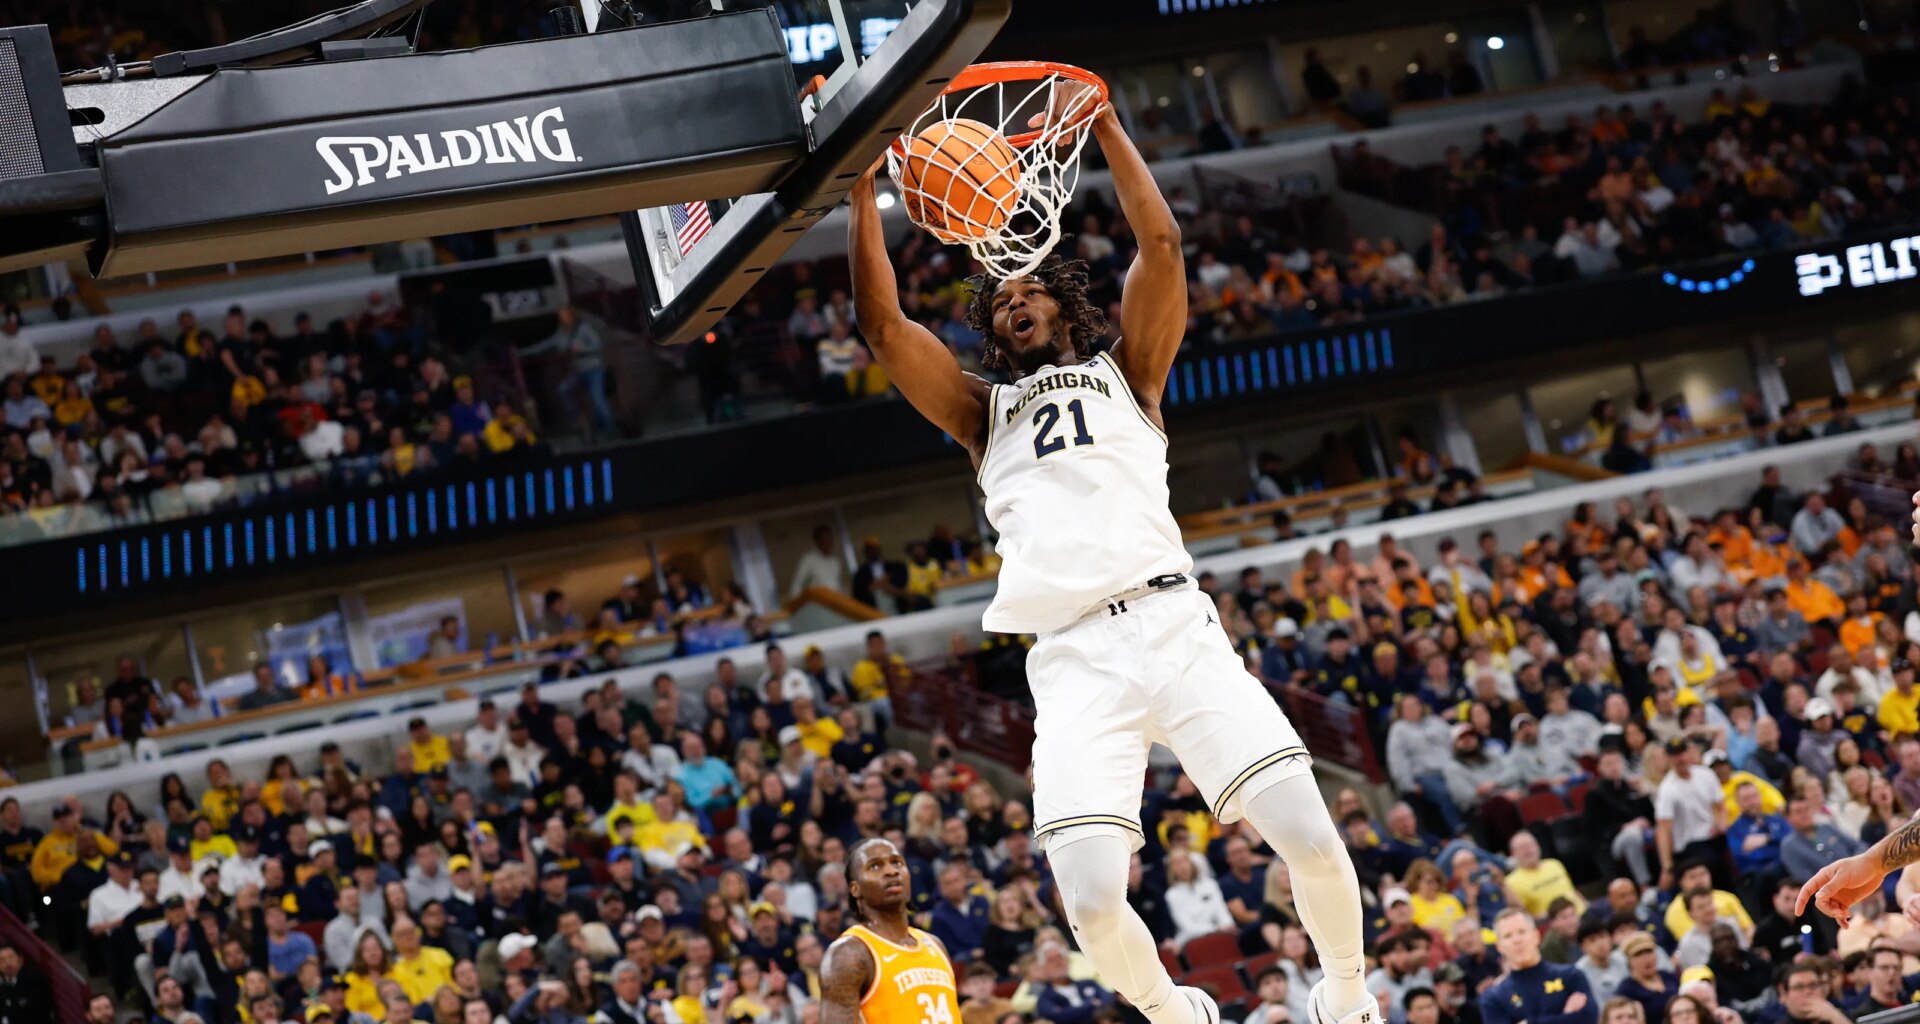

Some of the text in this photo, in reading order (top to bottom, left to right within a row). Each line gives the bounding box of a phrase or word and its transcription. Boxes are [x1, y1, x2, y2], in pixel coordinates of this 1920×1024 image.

[781, 23, 839, 64] IP
[315, 106, 577, 195] SPALDING
[1005, 372, 1112, 425] MICHIGAN
[1032, 398, 1095, 460] 21
[916, 992, 953, 1024] 34
